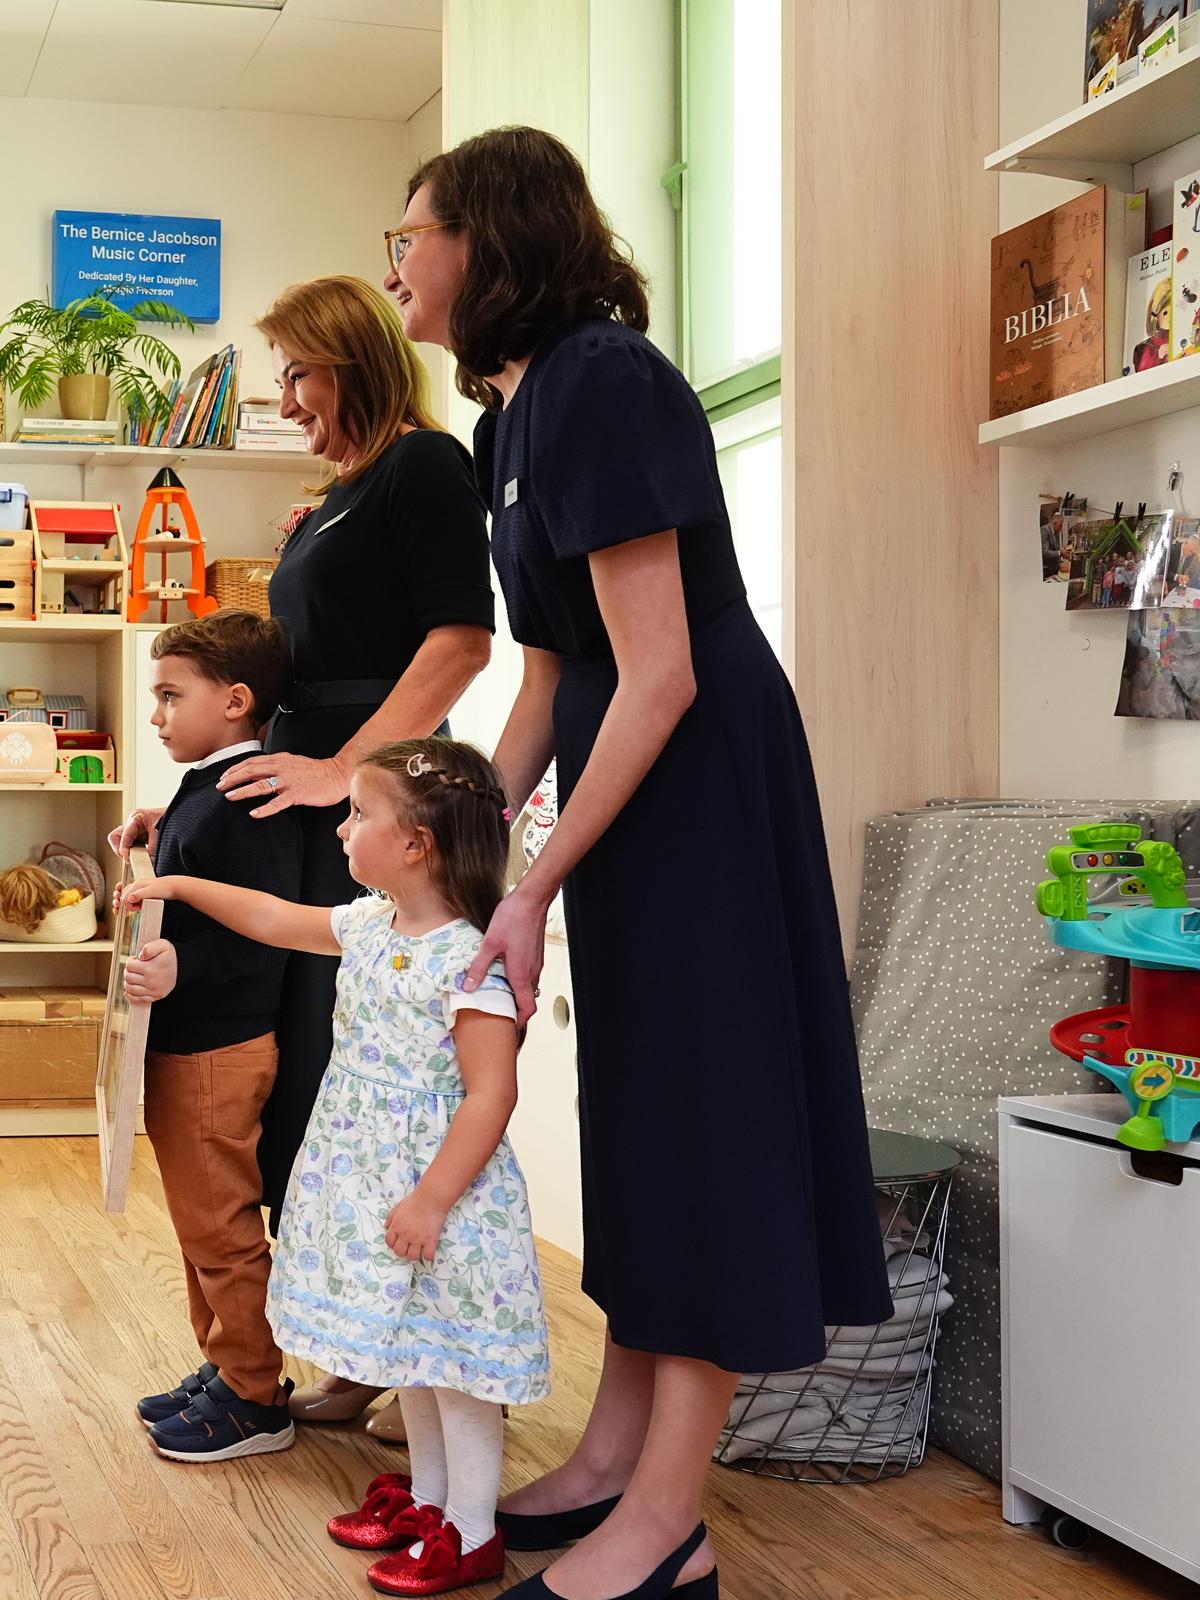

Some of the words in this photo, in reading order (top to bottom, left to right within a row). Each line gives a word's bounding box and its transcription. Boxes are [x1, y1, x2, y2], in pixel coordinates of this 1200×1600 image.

[60, 224, 88, 239] The
[91, 226, 145, 242] Bernice
[148, 230, 217, 246] Jacobson
[91, 246, 135, 261] Music
[138, 249, 187, 264] Corner
[78, 271, 124, 282] Dedicated
[125, 273, 137, 284] By
[138, 274, 154, 283] Her
[156, 275, 198, 287] Daughter,
[1003, 286, 1092, 344] BIBLIA
